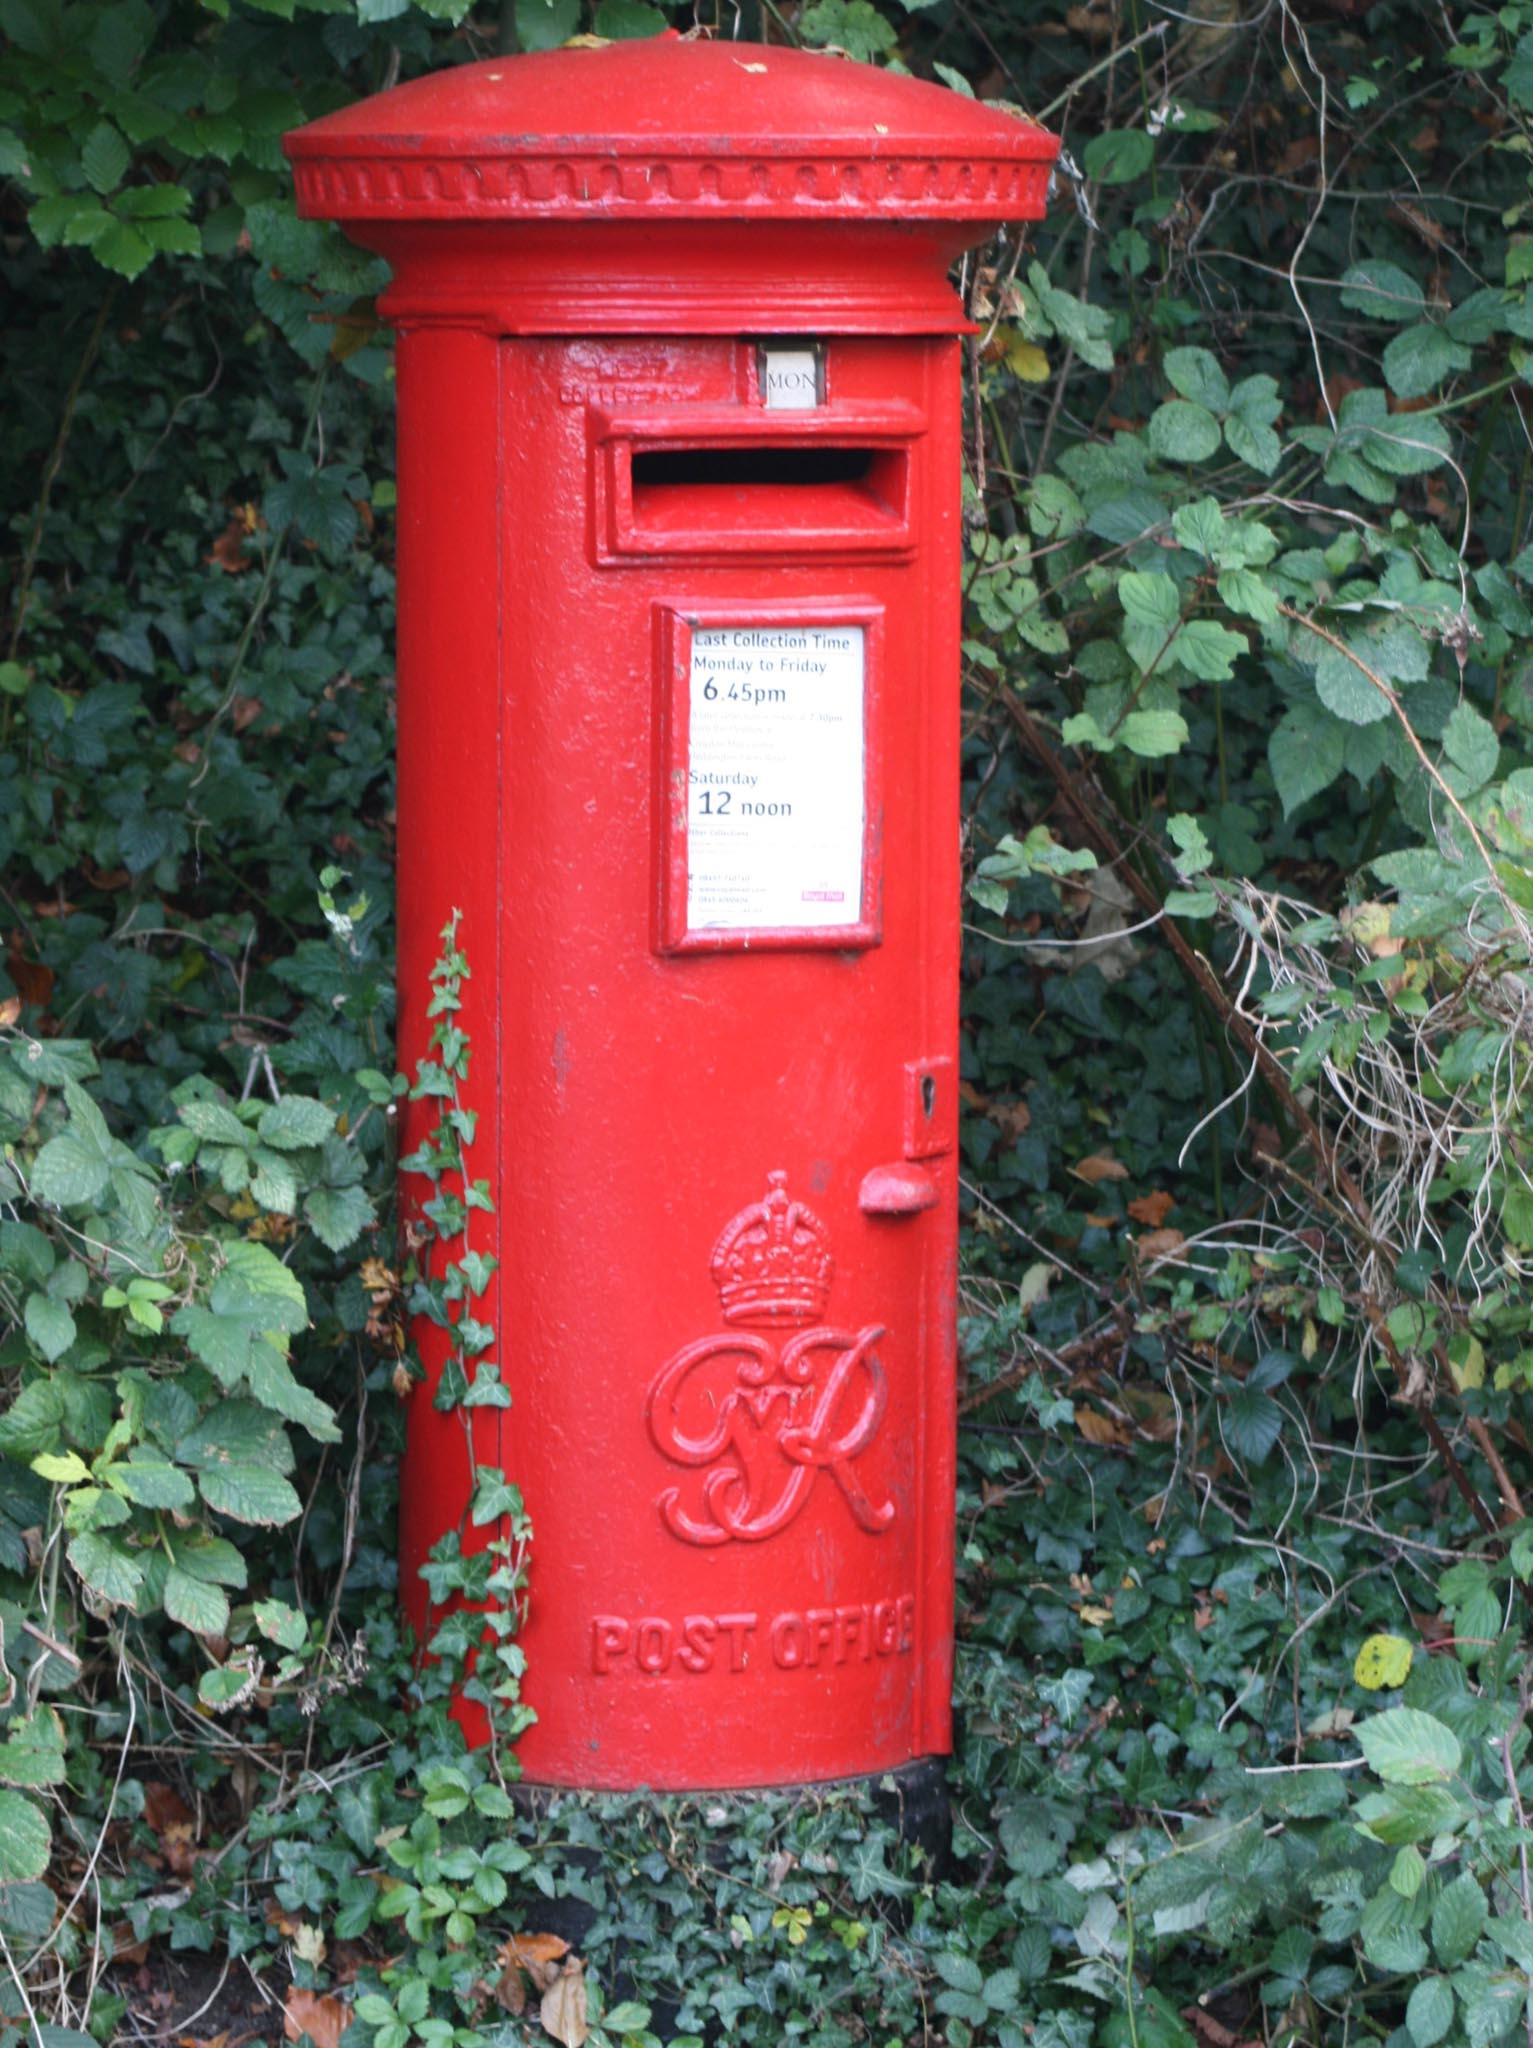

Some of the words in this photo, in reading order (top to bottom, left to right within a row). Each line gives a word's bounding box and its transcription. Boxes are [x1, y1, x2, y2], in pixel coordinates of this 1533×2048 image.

[768, 372, 816, 390] MON
[695, 632, 728, 648] Last
[733, 632, 807, 649] Collection
[812, 633, 851, 650] Time
[694, 655, 754, 674] Monday
[760, 658, 774, 672] to
[781, 656, 828, 677] Friday
[703, 676, 787, 706] 6.45pm
[689, 769, 759, 789] Saturday
[698, 790, 733, 815] 12
[741, 802, 793, 816] noon
[591, 1613, 758, 1676] POST
[771, 1593, 915, 1670] OFFICE
